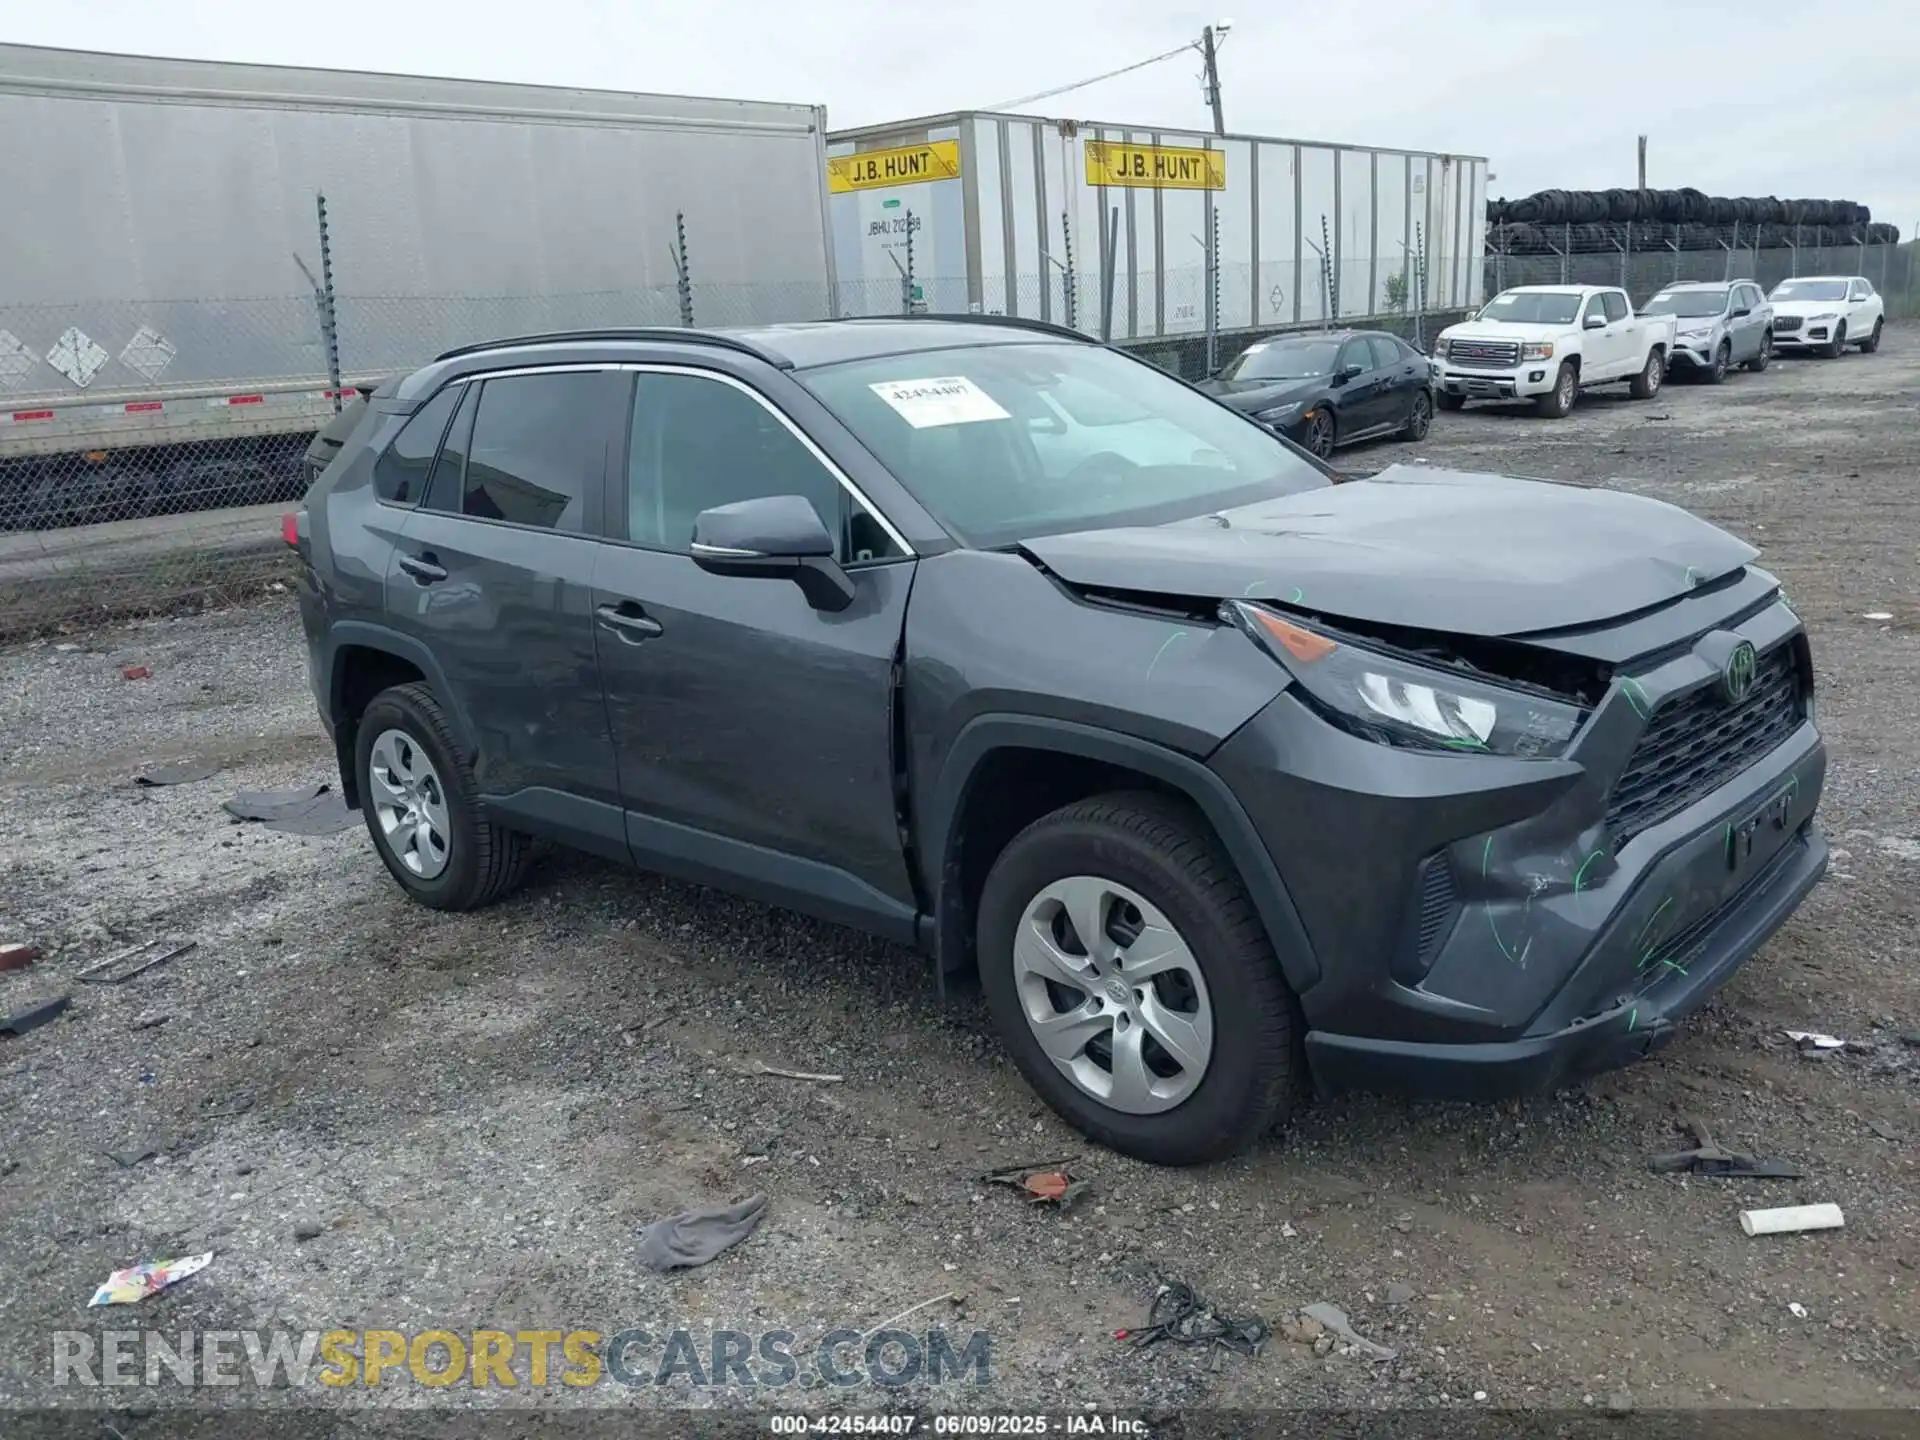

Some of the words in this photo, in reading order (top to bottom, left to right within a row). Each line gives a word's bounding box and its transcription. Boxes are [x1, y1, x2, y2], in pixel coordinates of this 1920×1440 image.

[853, 161, 882, 182] J.B.
[885, 152, 929, 177] HUNT
[1117, 153, 1149, 177] J.B.
[1155, 155, 1201, 180] HUNT
